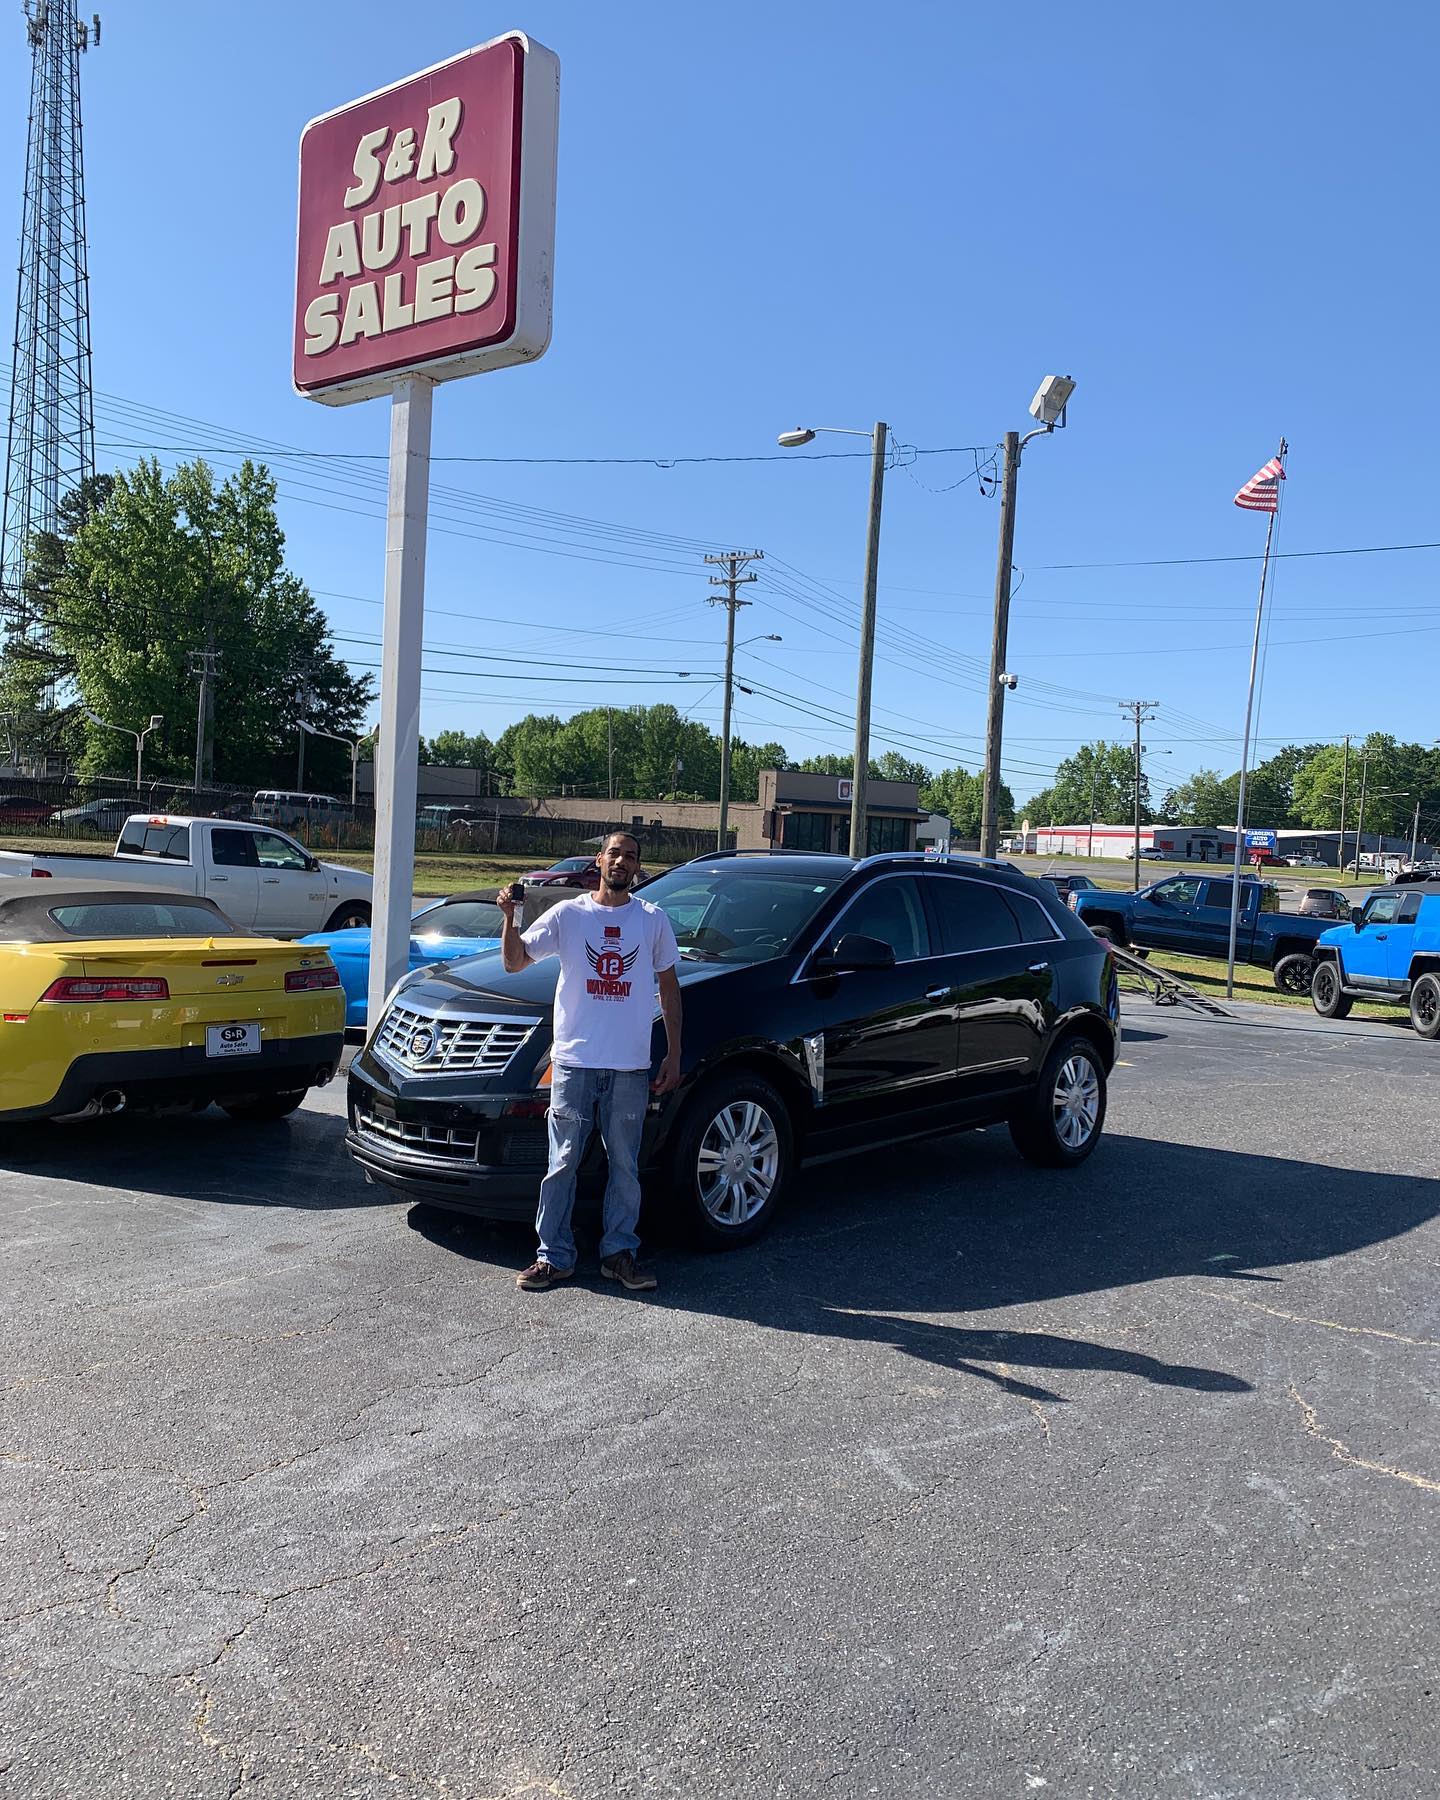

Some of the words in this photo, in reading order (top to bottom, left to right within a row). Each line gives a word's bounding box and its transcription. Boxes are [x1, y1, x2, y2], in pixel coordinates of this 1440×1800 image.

[343, 97, 463, 210] S&R
[319, 177, 487, 287] AUTO
[303, 243, 498, 357] SALES
[601, 958, 619, 975] 12
